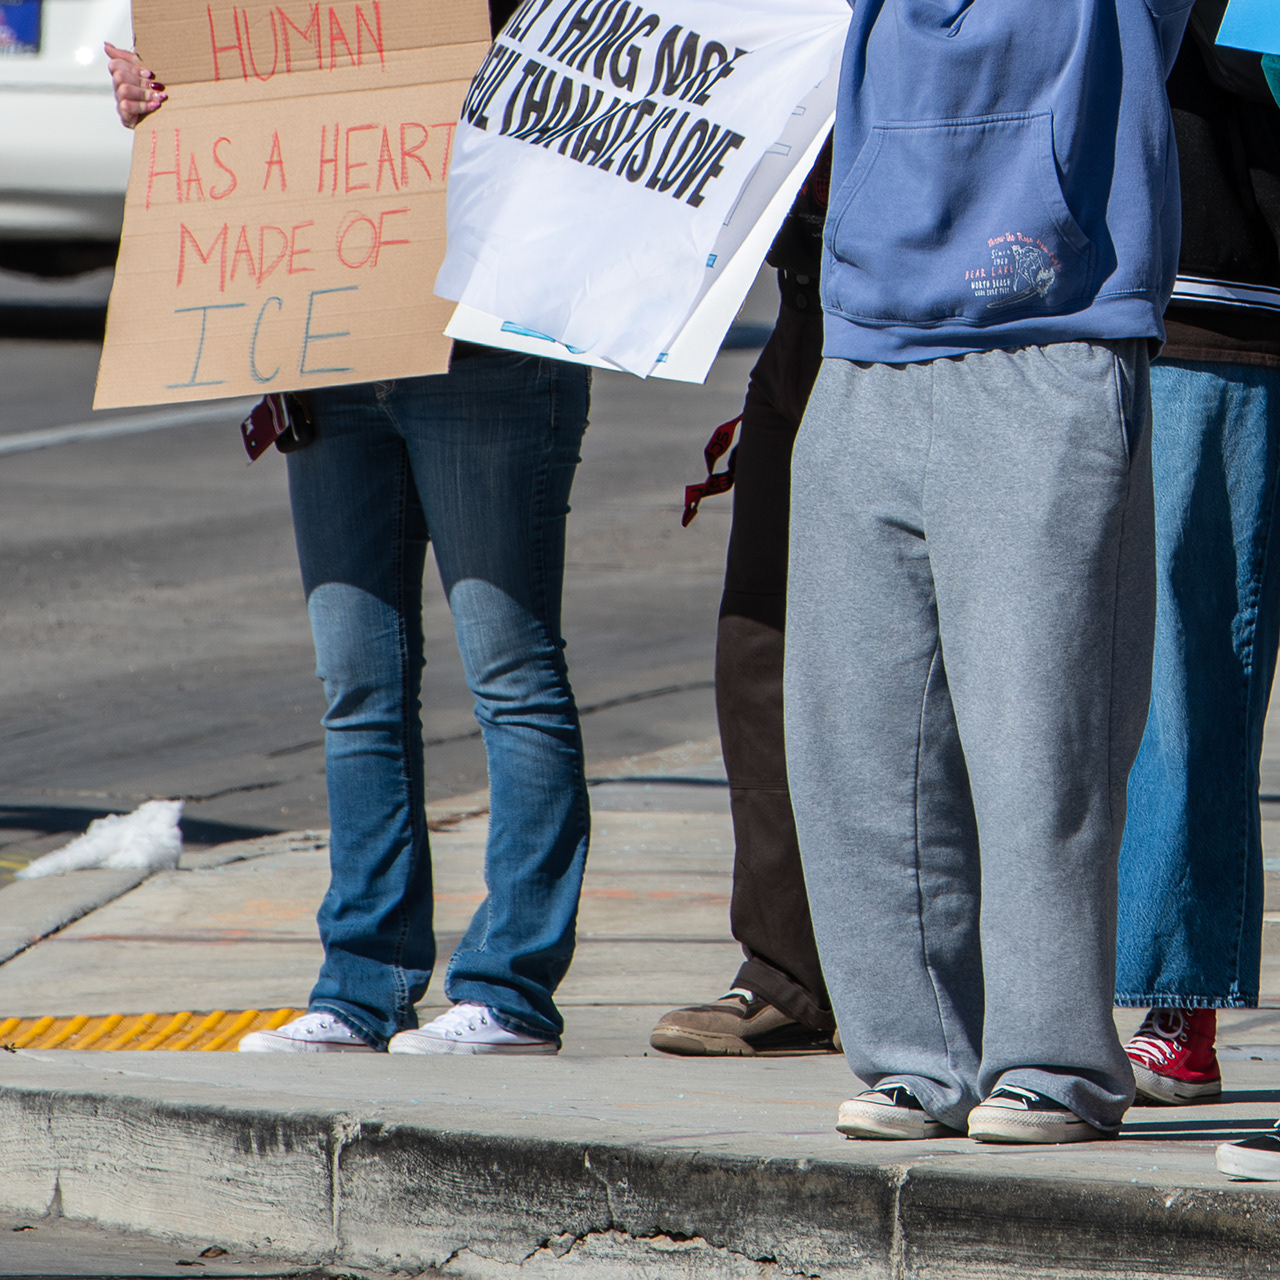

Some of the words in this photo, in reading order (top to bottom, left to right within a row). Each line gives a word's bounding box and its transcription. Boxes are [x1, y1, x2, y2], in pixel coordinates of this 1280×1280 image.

[144, 126, 240, 212] HAS
[262, 129, 289, 193] A
[317, 120, 460, 198] HEART
[644, 110, 746, 209] LOVE
[175, 218, 317, 293] MADE
[335, 206, 413, 270] OF
[164, 284, 361, 390] ICE
